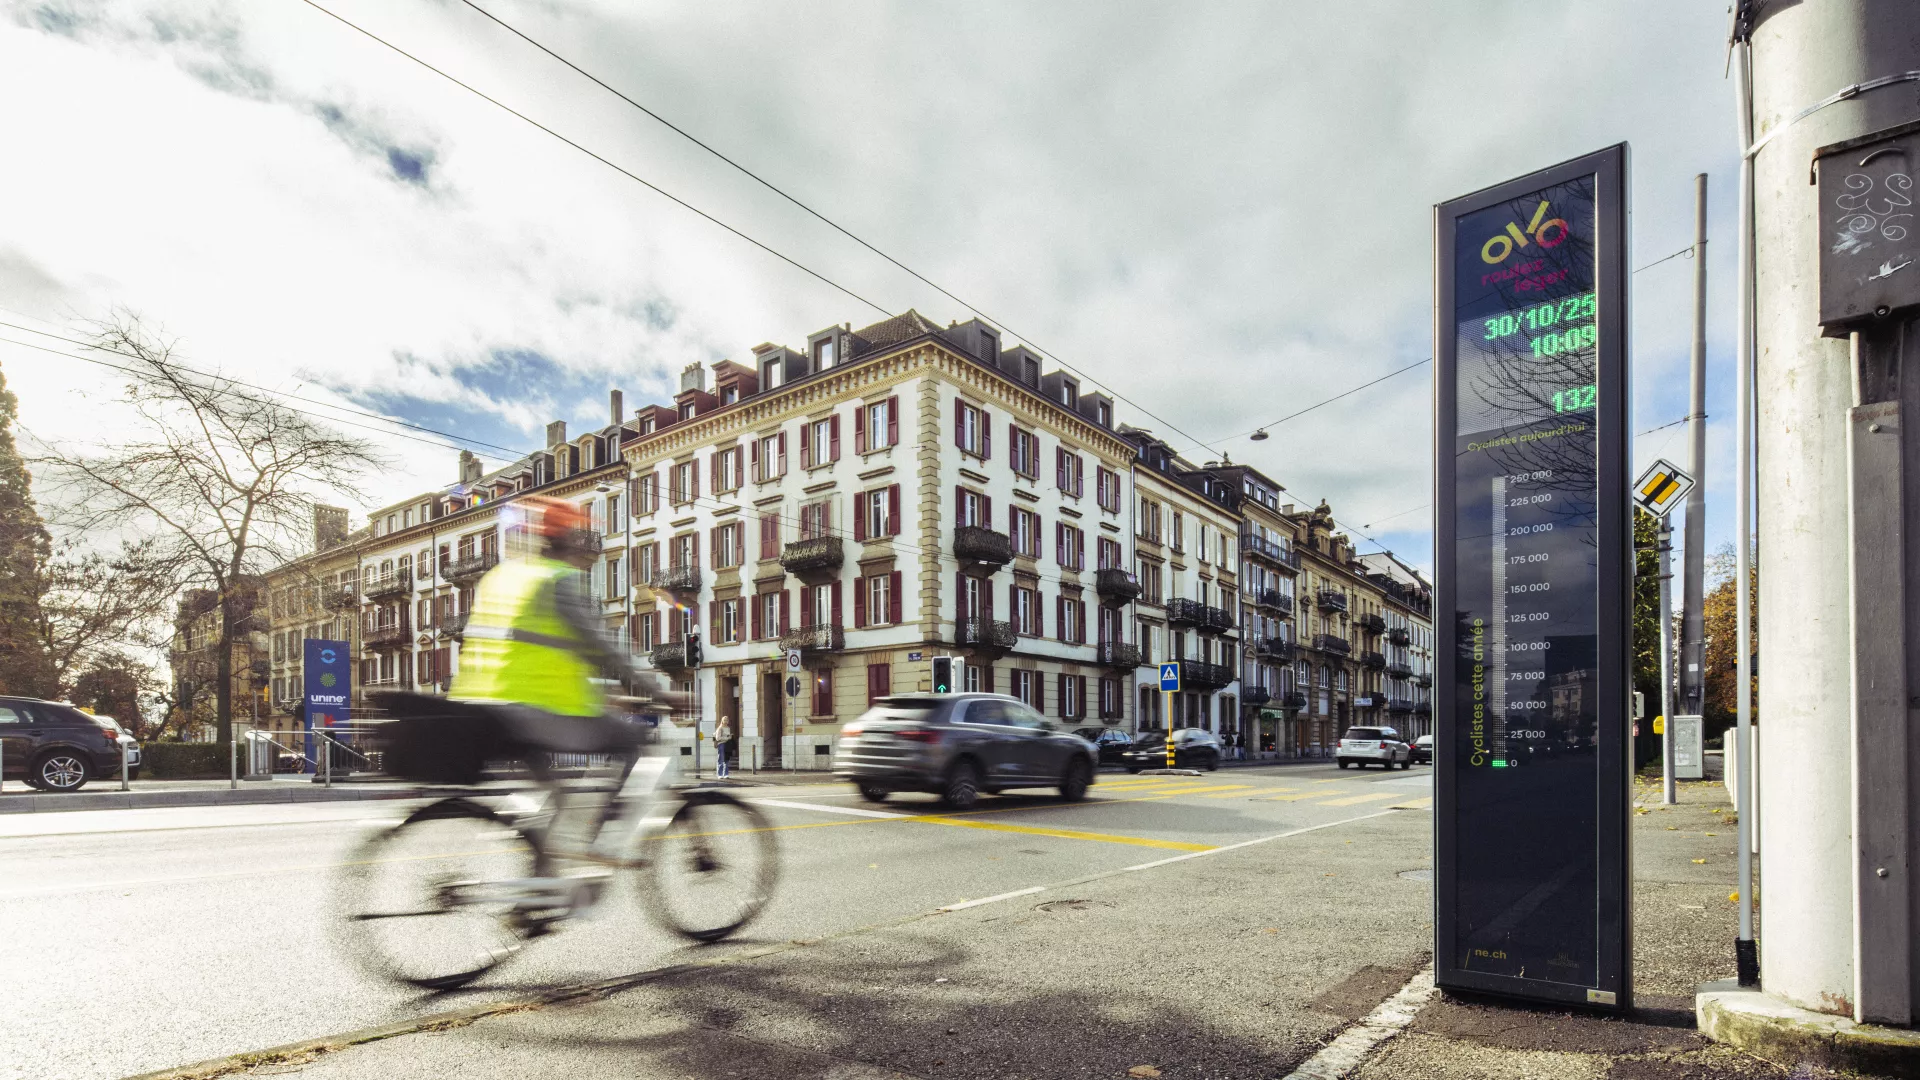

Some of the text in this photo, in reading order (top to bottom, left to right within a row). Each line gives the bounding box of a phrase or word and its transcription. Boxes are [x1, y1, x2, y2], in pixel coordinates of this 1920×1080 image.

[1481, 259, 1544, 286] roulez
[1484, 292, 1596, 340] 30/10/25
[1530, 323, 1596, 358] 10:09
[1552, 384, 1596, 413] 132
[1467, 421, 1585, 452] Cyclistes aujourd'hui
[1510, 469, 1552, 484] 250 000
[1510, 493, 1552, 507] 225 000
[1510, 523, 1553, 536] 200 000
[1510, 553, 1549, 565] 175 000
[1510, 582, 1550, 594] 150 000
[1510, 612, 1549, 623] 125 000
[1510, 641, 1550, 652] 100 000
[1510, 671, 1545, 681] 75 000
[1470, 618, 1484, 766] Cyclistes cette année
[1510, 700, 1546, 710] 50 000
[1510, 730, 1546, 739] 25 000
[1510, 759, 1518, 768] 0
[1475, 949, 1507, 960] ne.ch
